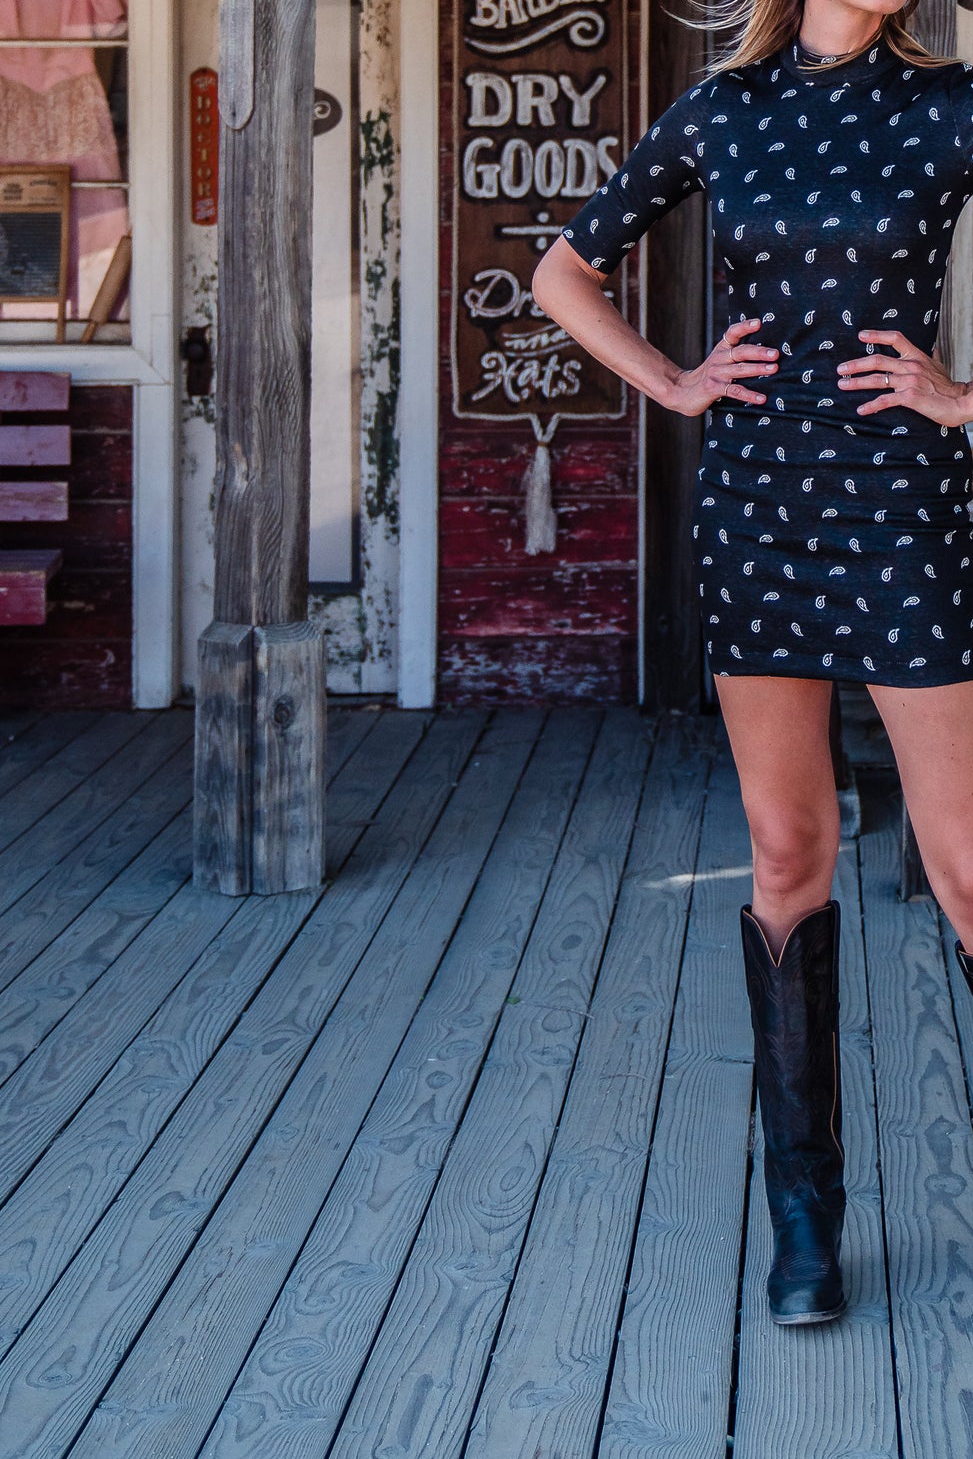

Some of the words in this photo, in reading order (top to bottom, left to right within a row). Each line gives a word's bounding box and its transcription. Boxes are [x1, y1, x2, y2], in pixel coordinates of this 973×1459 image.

[465, 73, 606, 127] DRY
[463, 137, 619, 198] GOODS
[471, 351, 582, 402] Hats
